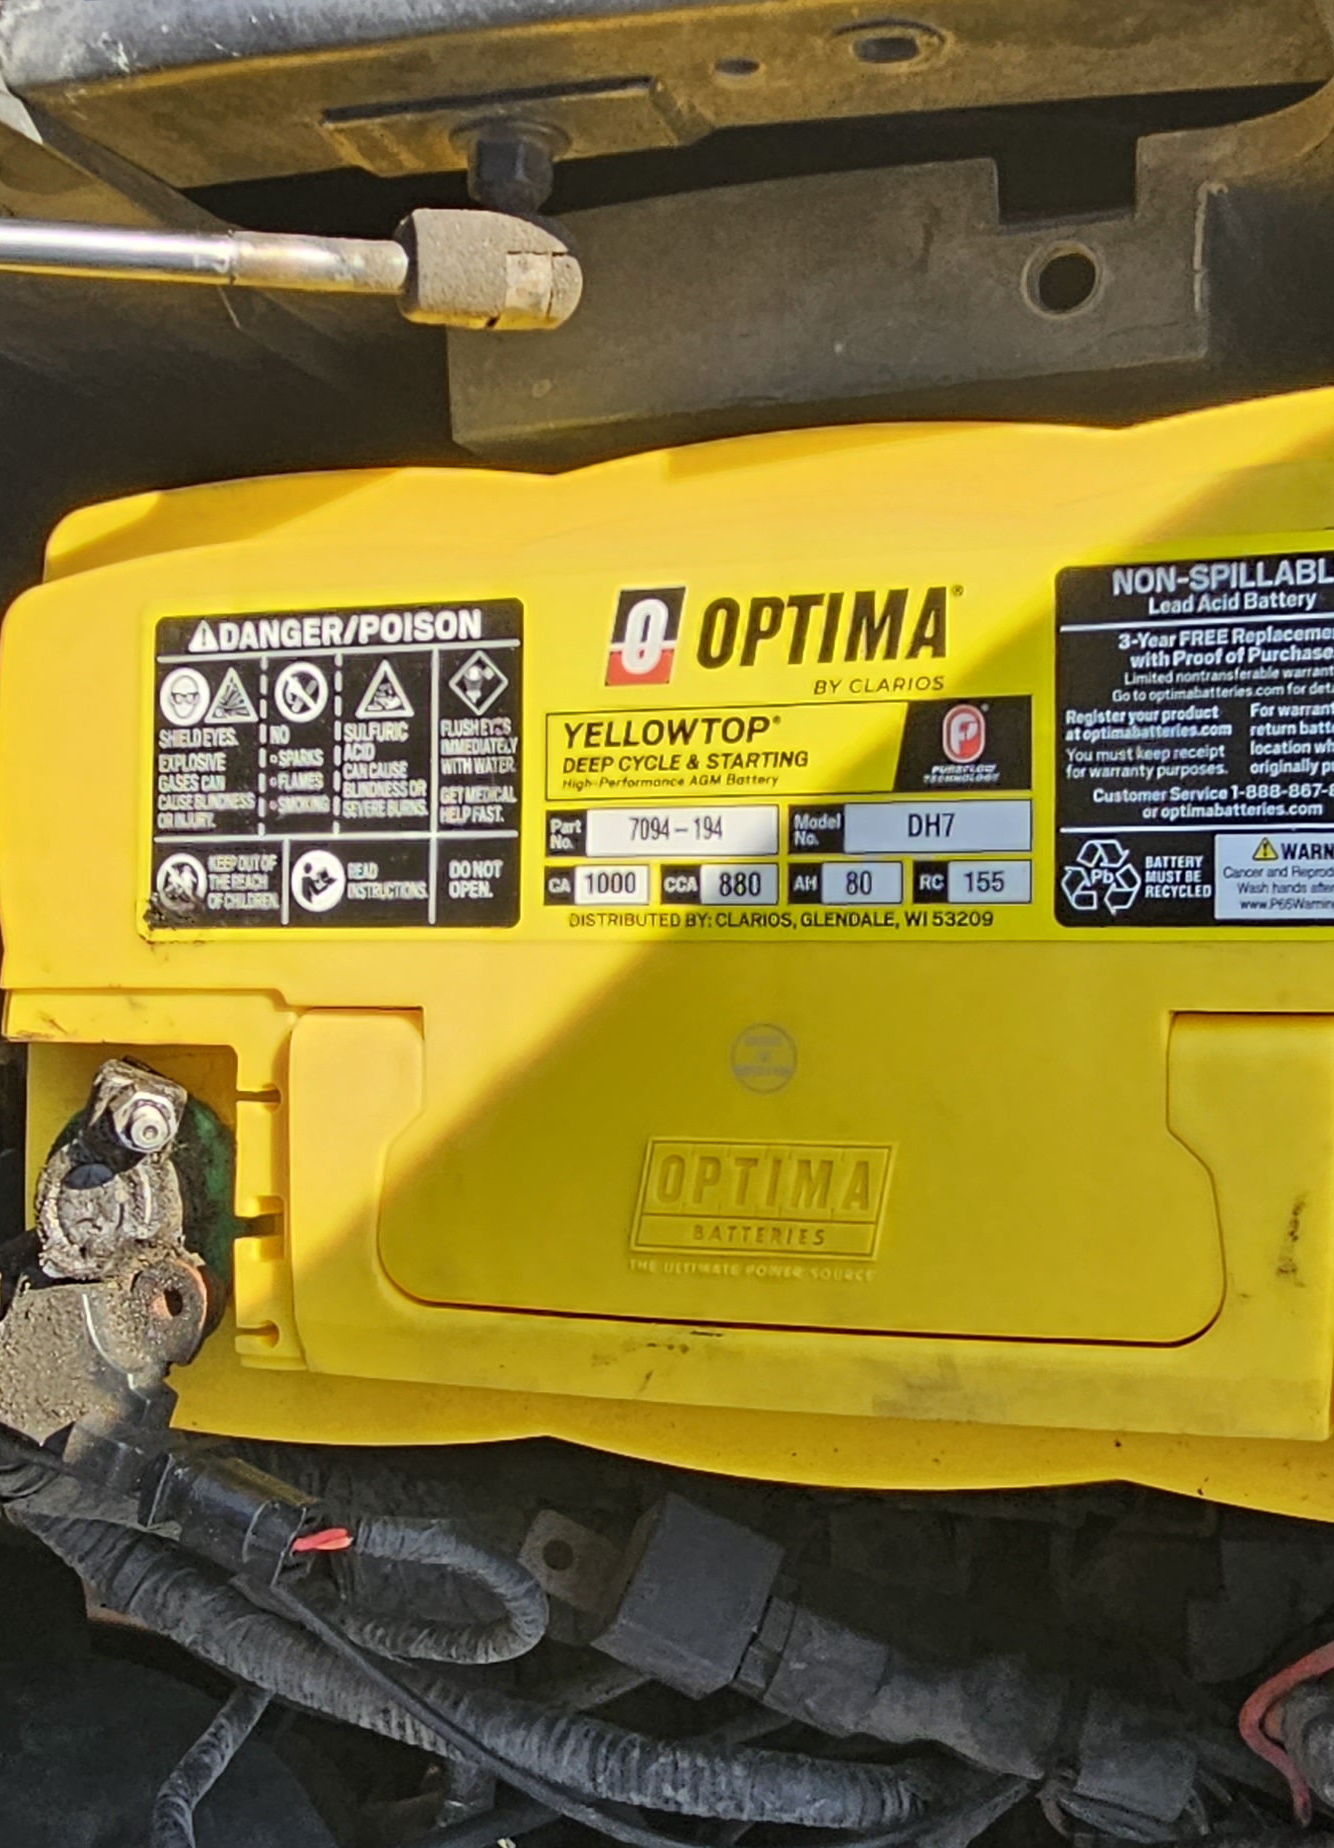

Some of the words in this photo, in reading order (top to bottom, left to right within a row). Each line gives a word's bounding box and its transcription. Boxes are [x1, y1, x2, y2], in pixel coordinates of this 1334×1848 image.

[1148, 596, 1194, 615] Lead
[1197, 593, 1240, 613] Acid
[1244, 591, 1317, 611] Battery
[219, 609, 482, 650] DANGER/POISON
[1118, 632, 1177, 650] 3-Year
[1179, 629, 1229, 647] FREE
[1130, 651, 1170, 668] with
[1172, 648, 1223, 667] Proof
[1225, 648, 1245, 664] of
[813, 679, 841, 696] BY
[849, 675, 946, 694] CLARIOS
[1124, 671, 1173, 685] Limited
[1176, 667, 1280, 683] nontransferable
[1112, 689, 1132, 702] Go
[1133, 689, 1147, 702] to
[1149, 684, 1285, 702] optimabatteries.com
[1287, 682, 1307, 696] for
[1065, 709, 1127, 726] Register
[1128, 710, 1160, 725] your
[1161, 705, 1220, 724] product
[1250, 702, 1276, 718] For
[269, 724, 291, 745] NO
[343, 721, 409, 742] SULFURIC
[440, 718, 479, 737] FLUSH
[1065, 727, 1081, 741] at
[1083, 723, 1233, 743] optimabatteries.com
[1250, 722, 1297, 736] return
[158, 728, 201, 748] SHIELD
[202, 727, 240, 747] EYES.
[440, 737, 518, 756] IMMEDIATELY
[343, 742, 376, 762] ACID
[1065, 747, 1094, 762] You
[1096, 747, 1134, 761] must
[1136, 745, 1171, 763] keep
[1173, 744, 1225, 761] receipt
[1250, 740, 1312, 756] location
[158, 752, 227, 773] EXPLOSIVE
[342, 762, 368, 780] CAN
[369, 760, 409, 779] CAUSE
[440, 757, 473, 775] WITH
[473, 756, 516, 774] WATER.
[563, 756, 614, 775] DEEP
[618, 754, 681, 772] CYCLE
[686, 754, 700, 770] &
[706, 750, 809, 770] STARTING
[1065, 764, 1087, 778] for
[1089, 764, 1154, 780] warranty
[1156, 762, 1229, 778] purposes.
[1250, 759, 1319, 776] originally
[158, 773, 200, 793] GASES
[201, 775, 226, 792] CAN
[342, 780, 408, 799] BLINDNESS
[409, 778, 427, 798] OR
[562, 774, 685, 792] High-Performance
[689, 773, 722, 788] AGM
[726, 771, 780, 789] Battery
[158, 793, 194, 811] CAUSE
[440, 786, 464, 805] GET
[1093, 786, 1168, 803] Customer
[1169, 785, 1228, 801] Service
[440, 805, 471, 824] HELP
[471, 804, 505, 823] FAST.
[1142, 806, 1159, 819] or
[1160, 802, 1323, 821] optimabatteries.com
[550, 818, 581, 835] Part
[794, 812, 842, 831] Model
[907, 812, 956, 839] DH7
[550, 834, 574, 850] No.
[794, 830, 820, 846] No.
[208, 854, 236, 872] KEEP
[260, 853, 278, 871] OF
[448, 860, 471, 878] DO
[472, 859, 503, 878] NOT
[1145, 855, 1204, 870] BATTERY
[1223, 865, 1264, 879] Cancer
[1266, 865, 1289, 878] and
[208, 873, 230, 891] THE
[548, 878, 571, 894] CA
[584, 871, 637, 895] 1000
[663, 876, 698, 893] CCA
[718, 870, 762, 896] 880
[793, 875, 817, 892] AH
[845, 870, 873, 896] 80
[919, 874, 945, 890] RC
[963, 870, 1005, 892] 155
[1090, 870, 1115, 885] Pb
[1145, 870, 1183, 884] MUST
[1184, 869, 1202, 884] BE
[448, 880, 494, 898] OPEN.
[1144, 884, 1213, 898] RECYCLED
[1236, 880, 1268, 895] Wash
[1272, 880, 1308, 894] hands
[207, 892, 224, 908] OF
[569, 912, 681, 929] DISTRIBUTED
[684, 912, 713, 929] BY:
[715, 912, 797, 930] CLARIOS,
[801, 911, 900, 930] GLENDALE,
[905, 911, 928, 927] WI
[933, 911, 994, 928] 53209
[656, 1154, 871, 1211] OPTIMA
[692, 1224, 827, 1247] BATTERIES
